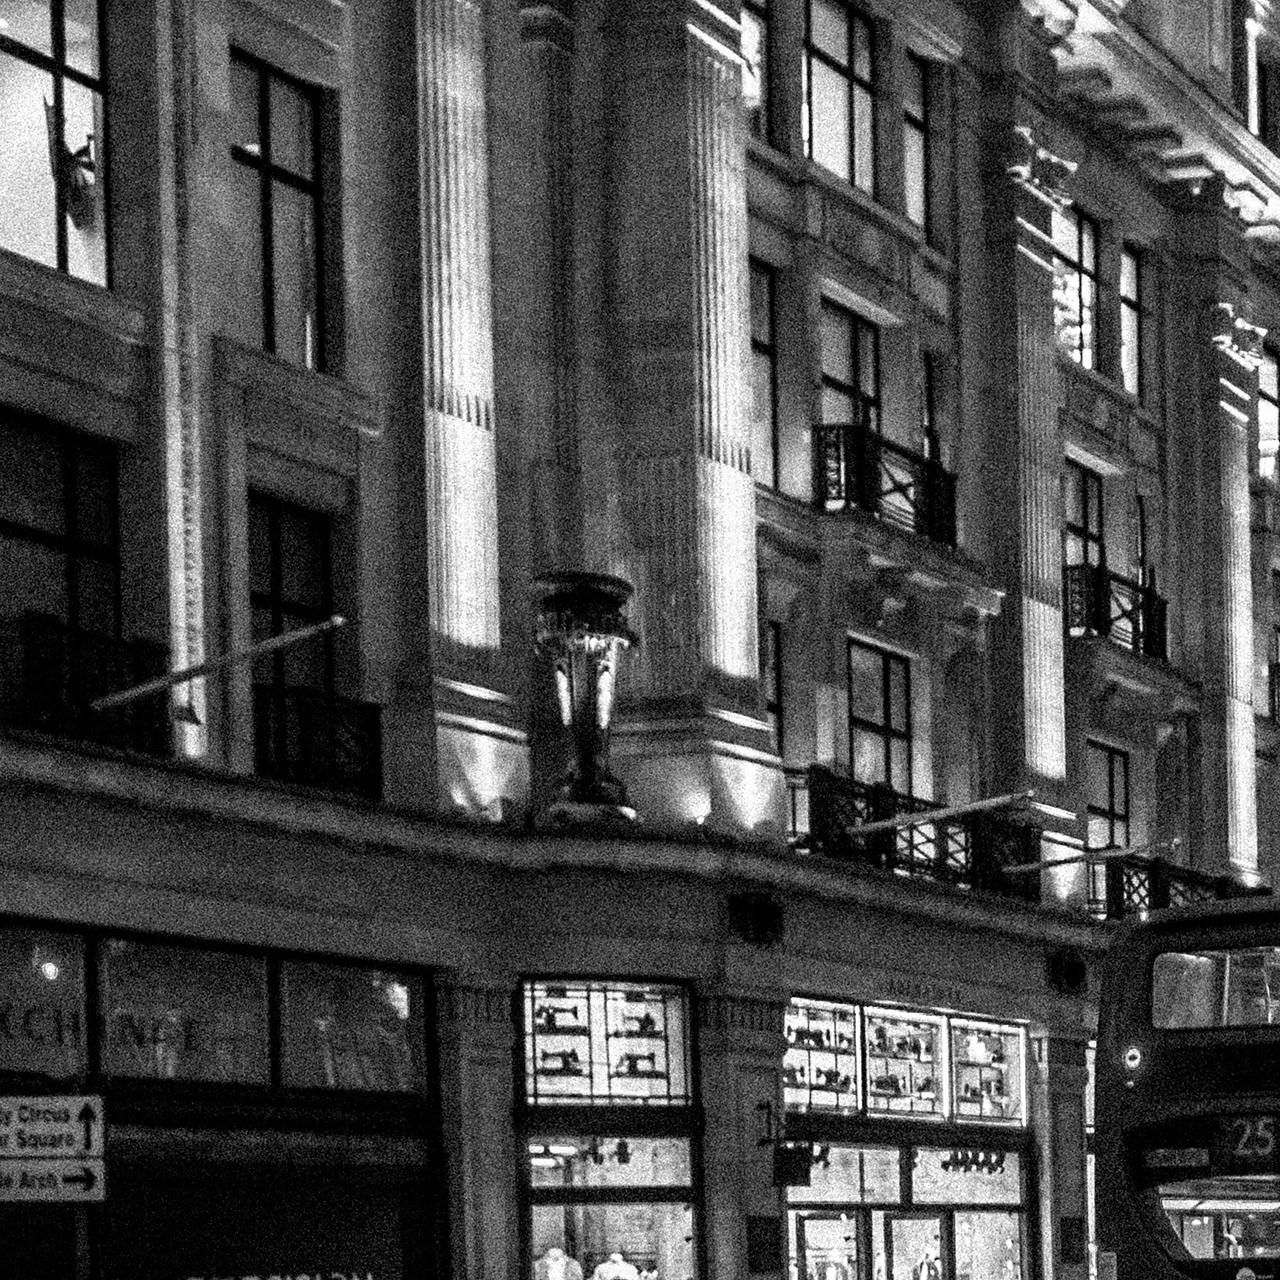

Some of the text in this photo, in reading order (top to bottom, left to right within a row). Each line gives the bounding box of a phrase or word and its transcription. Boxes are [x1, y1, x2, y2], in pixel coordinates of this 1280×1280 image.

[18, 1104, 70, 1123] Circus
[17, 1129, 75, 1150] Square
[1233, 1116, 1275, 1156] 25
[19, 1172, 57, 1189] Arch
